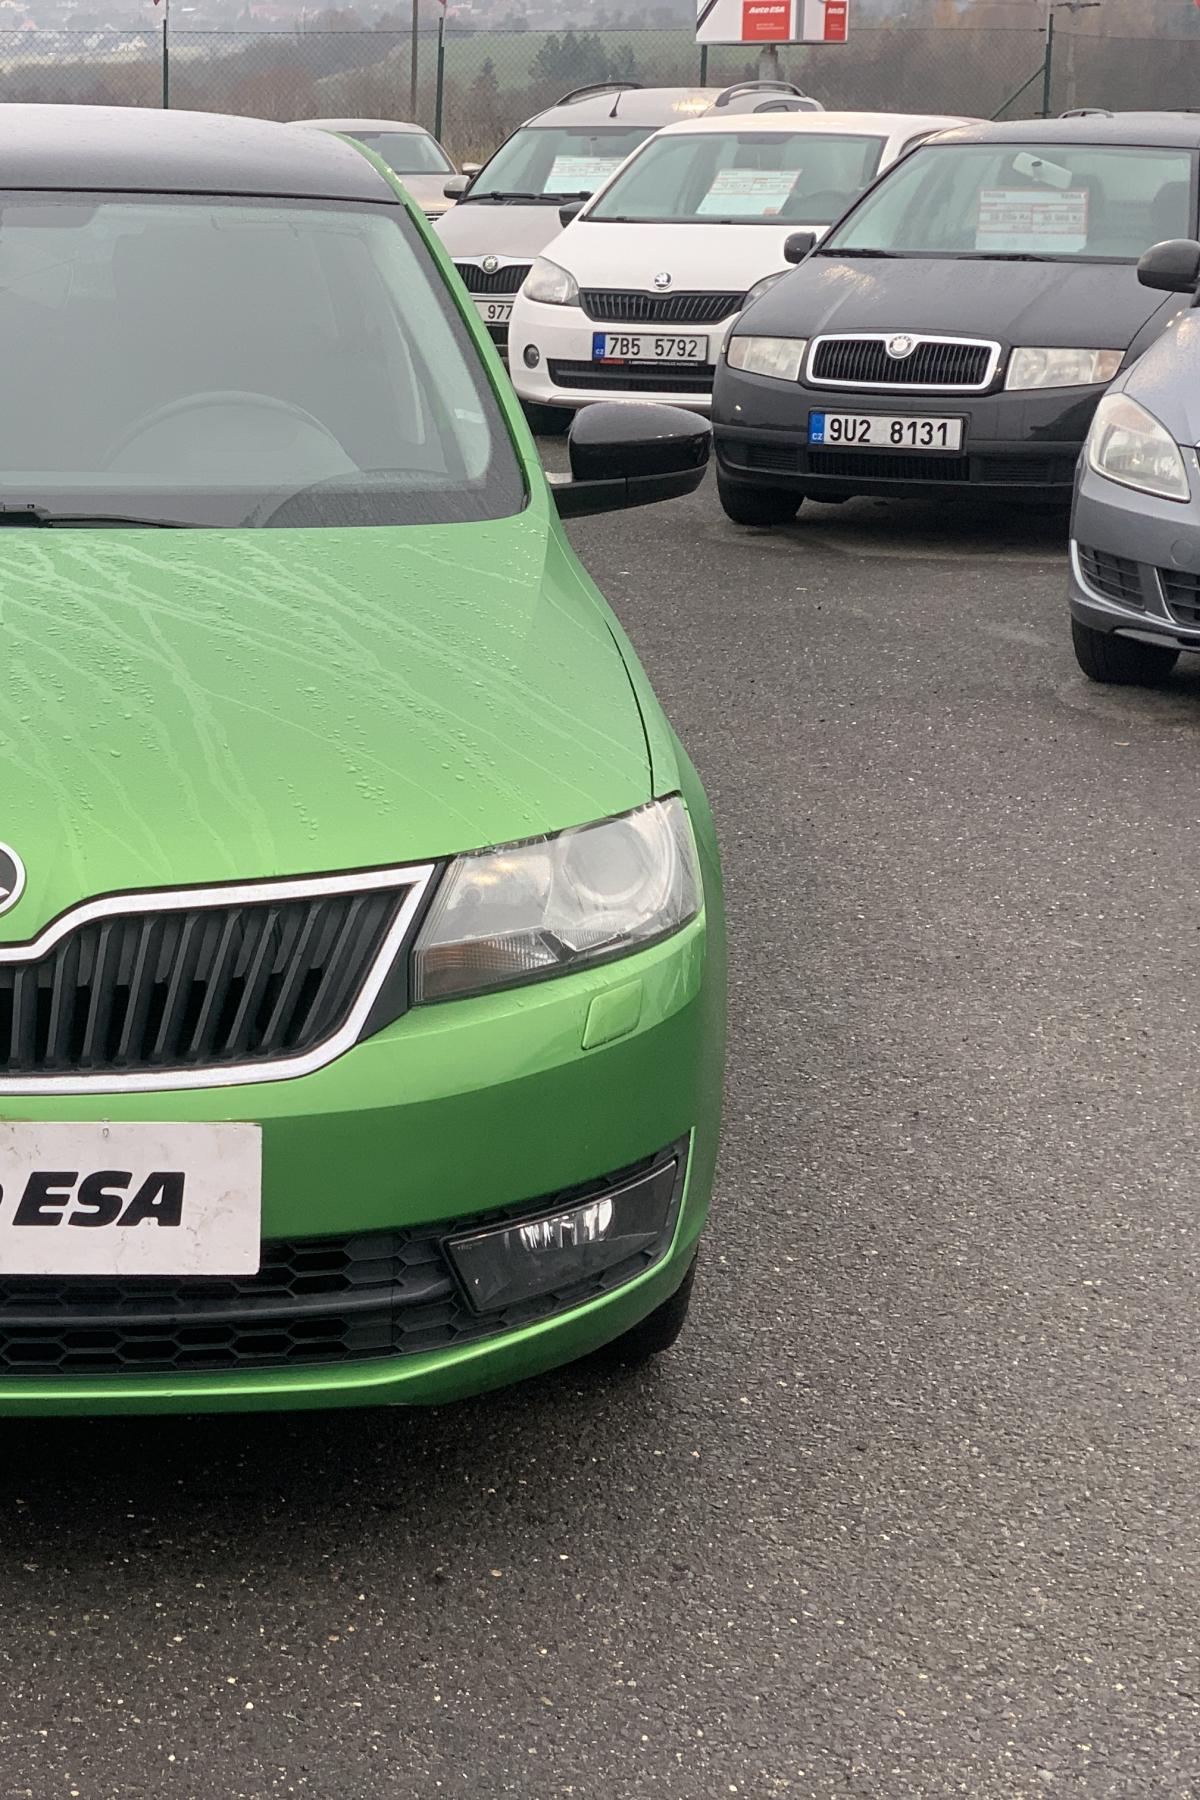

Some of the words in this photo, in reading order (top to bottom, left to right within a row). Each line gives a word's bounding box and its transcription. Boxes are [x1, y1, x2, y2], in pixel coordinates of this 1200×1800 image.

[488, 304, 513, 320] 977
[609, 337, 641, 356] 7B5
[655, 338, 698, 357] 5792
[830, 418, 871, 443] 9U2
[890, 420, 948, 446] 8131
[11, 1171, 186, 1227] ESA
